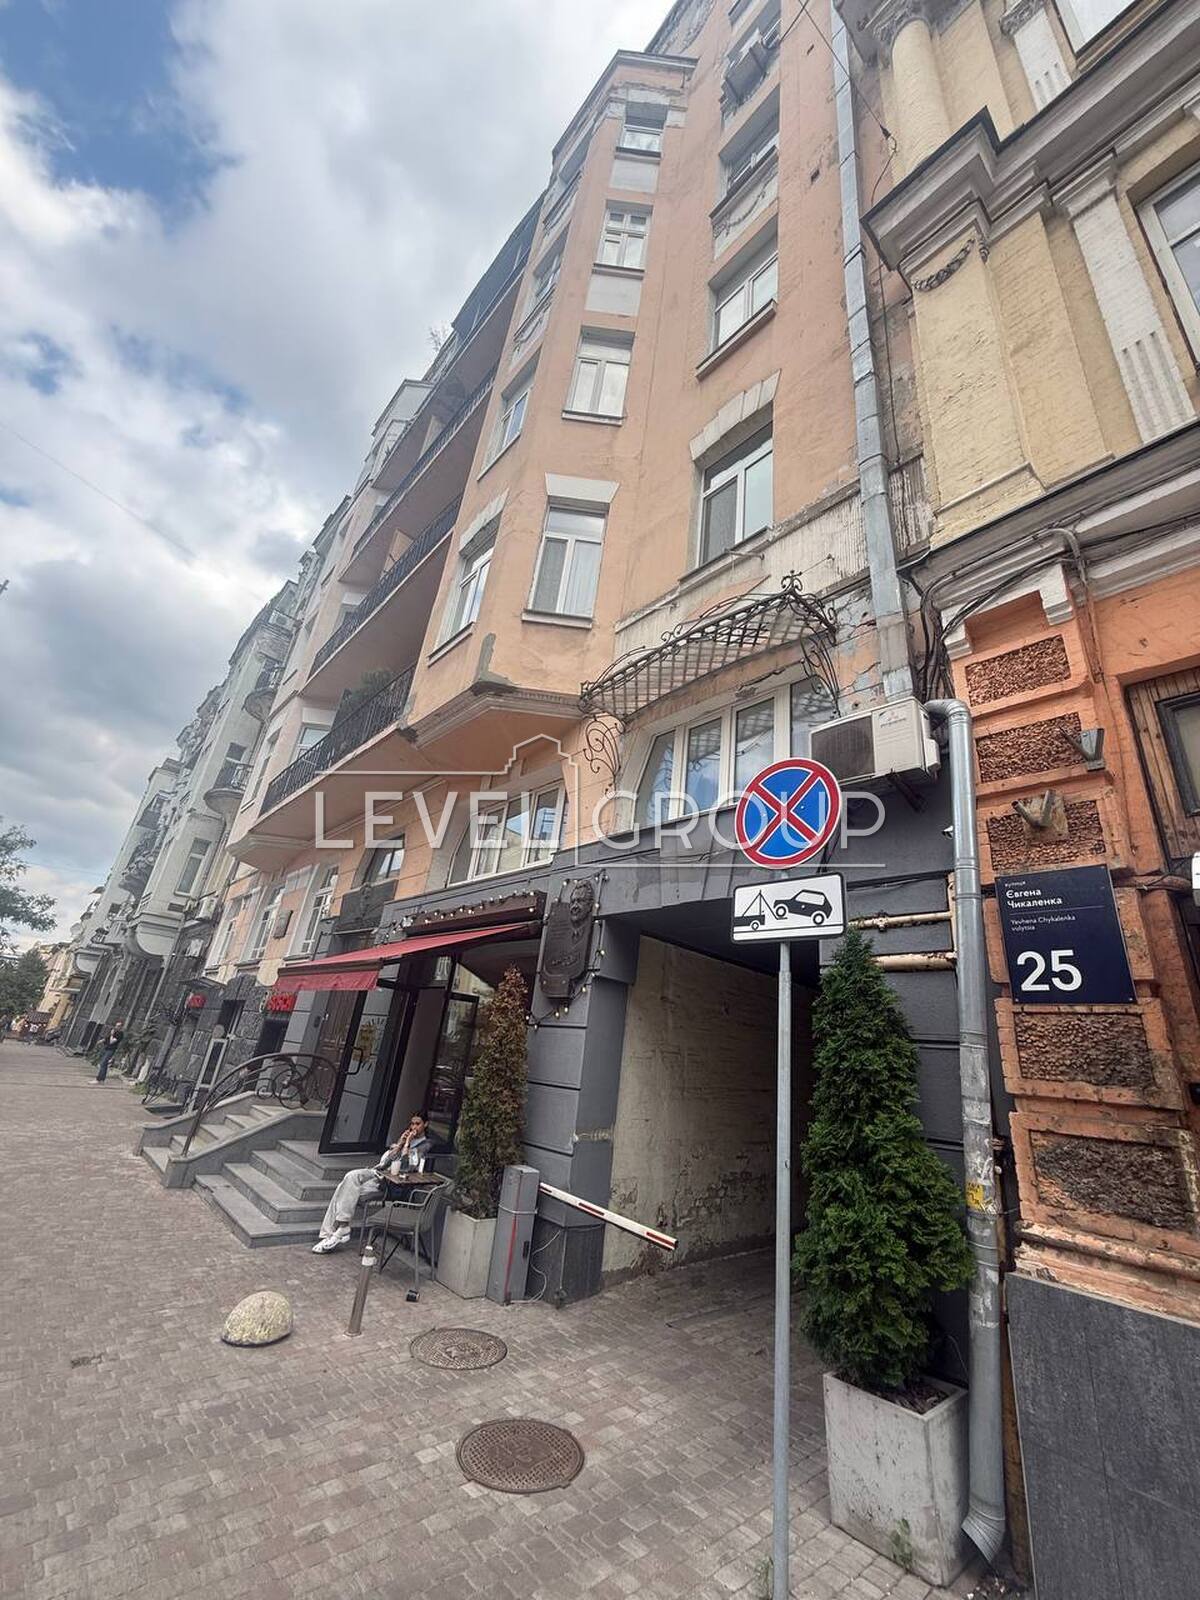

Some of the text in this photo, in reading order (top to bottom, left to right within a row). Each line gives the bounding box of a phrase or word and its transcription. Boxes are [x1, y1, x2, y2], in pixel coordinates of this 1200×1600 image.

[1006, 889, 1042, 899] Євгена
[1007, 898, 1063, 909] Чикаленка
[1016, 949, 1083, 992] 25
